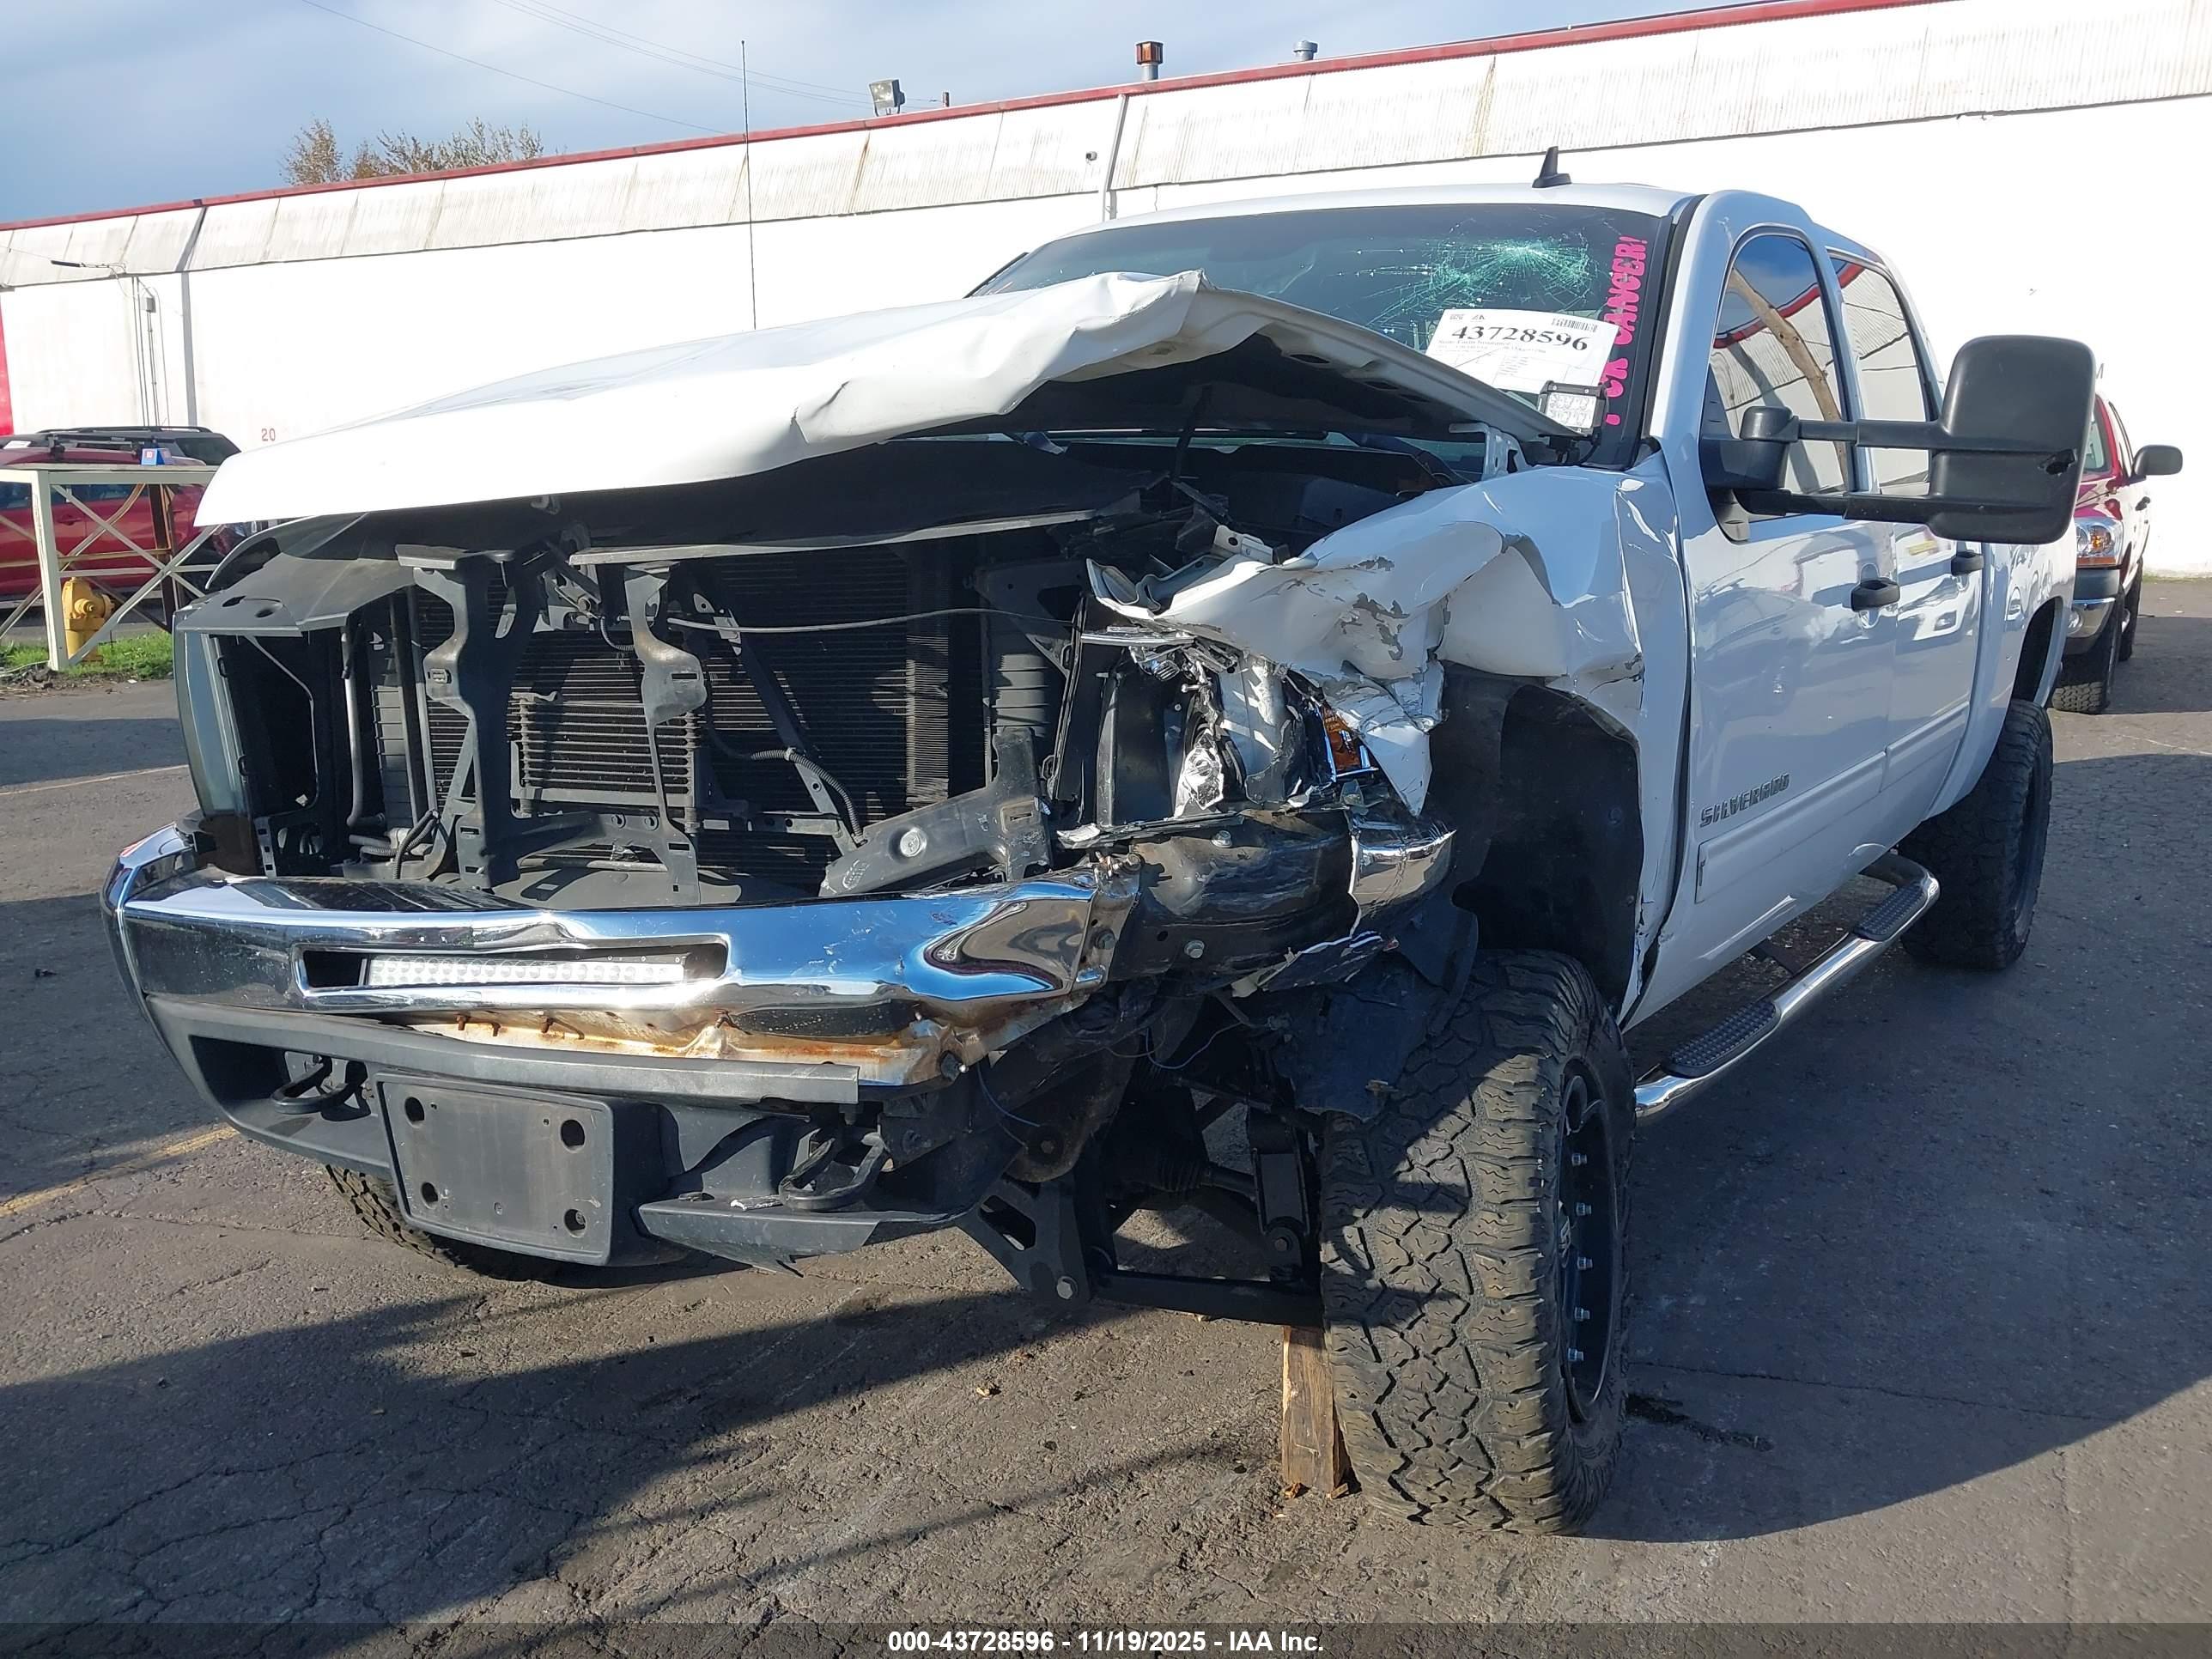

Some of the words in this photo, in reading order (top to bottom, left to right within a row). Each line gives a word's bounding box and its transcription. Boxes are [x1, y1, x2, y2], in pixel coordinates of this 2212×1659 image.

[1451, 325, 1591, 351] 43728596
[261, 428, 276, 441] 20
[1699, 772, 1790, 828] SILVERADO
